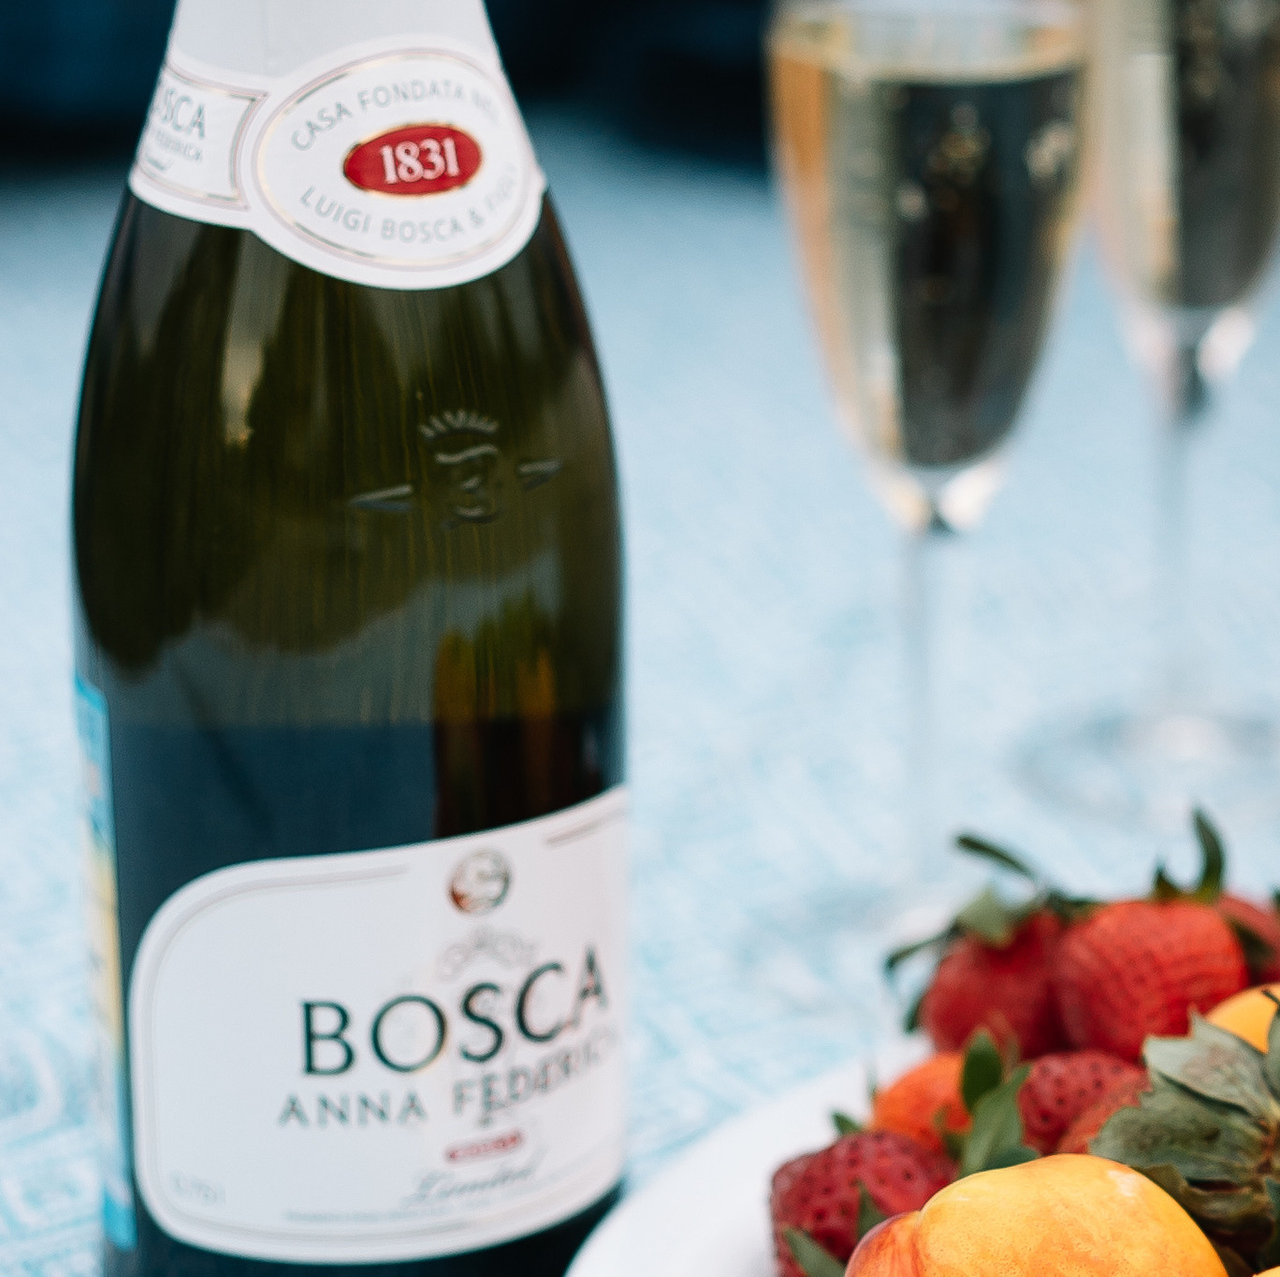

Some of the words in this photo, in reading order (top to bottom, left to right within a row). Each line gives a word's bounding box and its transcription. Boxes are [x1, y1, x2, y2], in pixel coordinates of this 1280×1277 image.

[160, 87, 206, 140] SCA
[290, 101, 354, 151] CASA
[357, 78, 466, 113] FONDATA
[379, 135, 461, 185] 1831
[299, 185, 372, 234] LUIGI
[380, 216, 466, 244] BOSCA
[298, 940, 612, 1078] BOSCA
[277, 1087, 429, 1130] ANNA
